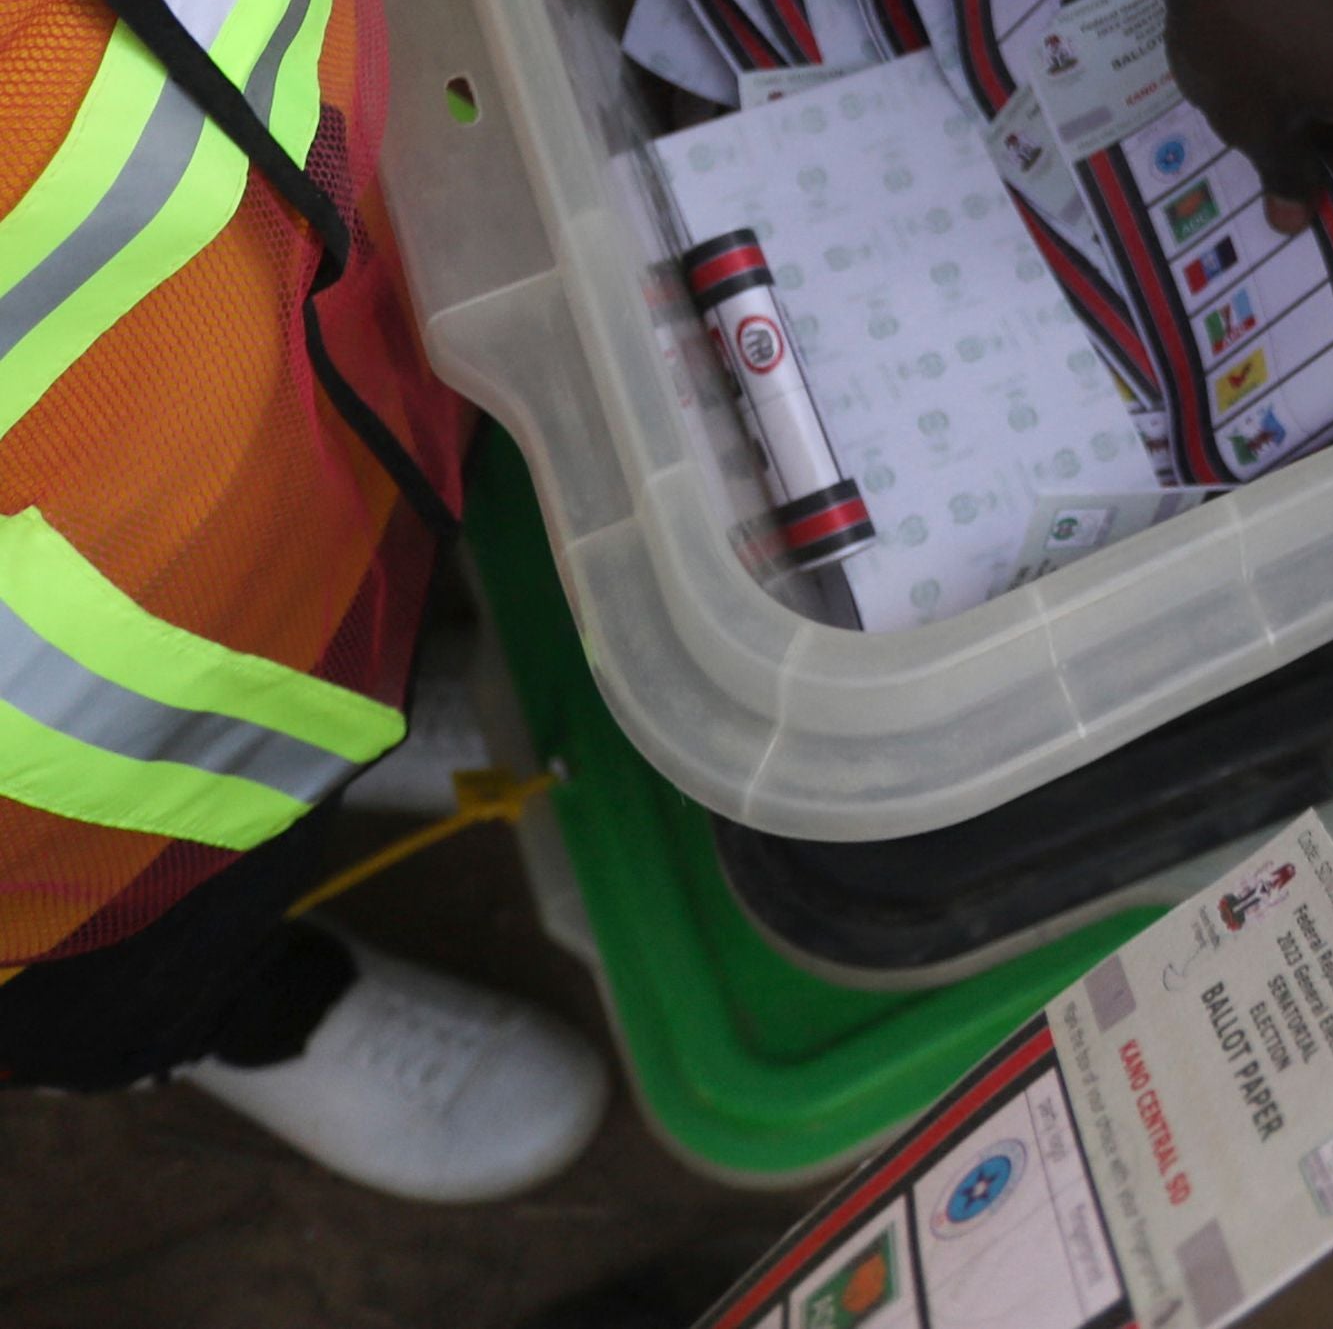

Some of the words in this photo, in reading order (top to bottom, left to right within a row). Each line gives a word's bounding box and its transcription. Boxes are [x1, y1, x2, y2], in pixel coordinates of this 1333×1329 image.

[1294, 903, 1328, 953] Federal
[1277, 930, 1303, 967] 2023
[1294, 964, 1329, 1018] General
[1201, 980, 1253, 1064] BALLOT
[1234, 1059, 1285, 1144] PAPER
[1250, 1001, 1292, 1073] ELECTION
[1267, 974, 1319, 1065] SENATORIAL
[1119, 1038, 1152, 1092] KANO
[1136, 1089, 1179, 1178] CENTRAL
[1165, 1172, 1193, 1207] SD
